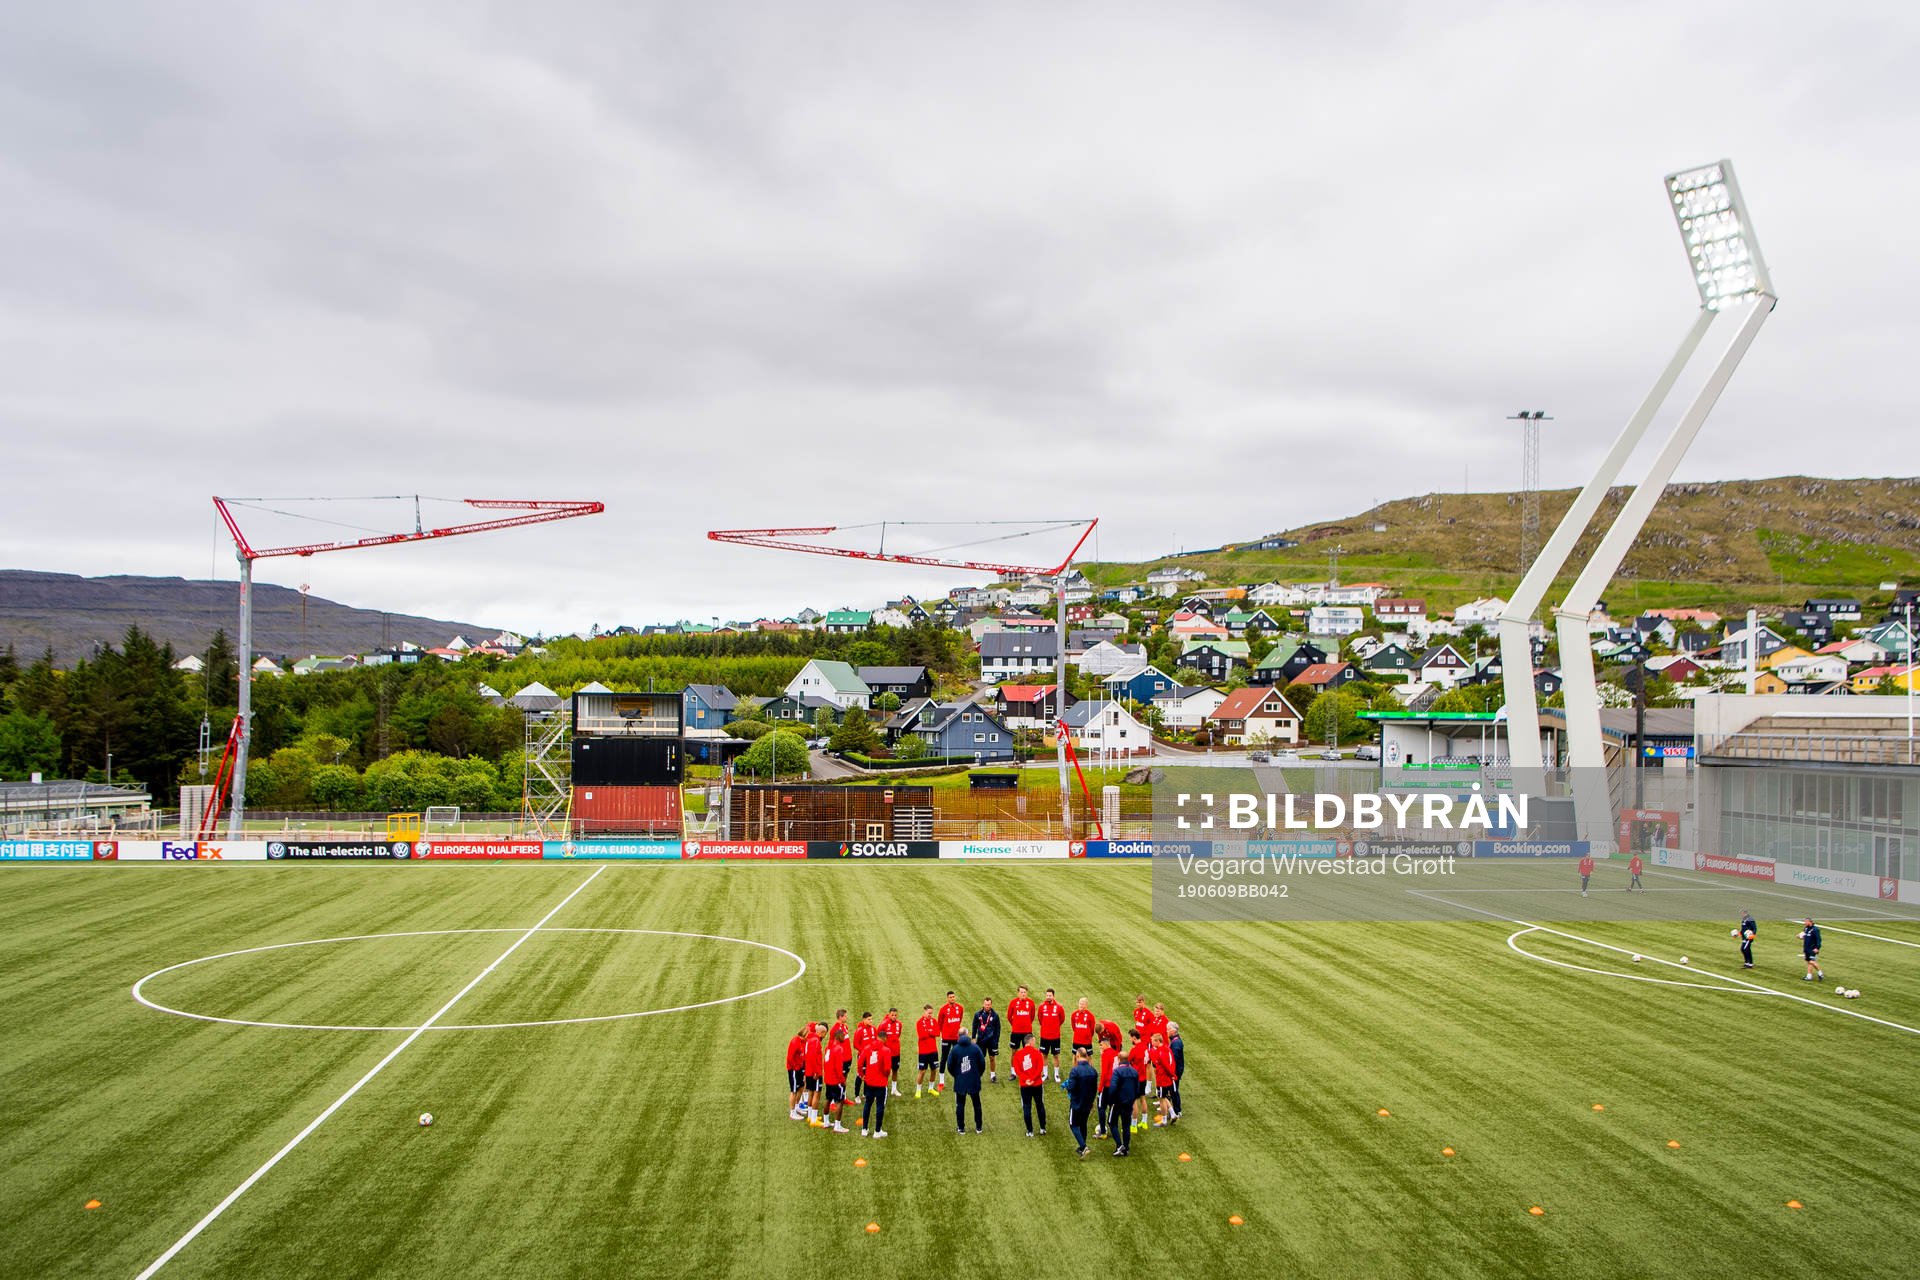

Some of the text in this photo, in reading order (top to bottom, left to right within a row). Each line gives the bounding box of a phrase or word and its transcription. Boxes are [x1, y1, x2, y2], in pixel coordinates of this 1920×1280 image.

[162, 842, 223, 859] FedEx
[288, 846, 310, 856] The
[311, 846, 372, 856] all-electric
[433, 845, 540, 856] EUROPEAN QUALIFIERS
[580, 845, 665, 855] UEFA EURO 2020
[702, 845, 805, 855] EUROPEAN QUALIFIERS
[851, 843, 908, 857] SOCAR
[963, 844, 1043, 854] Hisense 4K TV
[1108, 842, 1191, 857] Booking.com
[1248, 843, 1268, 855] PAY
[1268, 843, 1297, 855] WITH
[1298, 843, 1334, 855] ALIPAY
[1371, 845, 1389, 855] The
[1390, 845, 1441, 855] all-electric
[1493, 842, 1571, 857] Booking.com
[1706, 858, 1774, 876] EUROPEAN QUALIFIERS
[1792, 870, 1832, 885] Hisense
